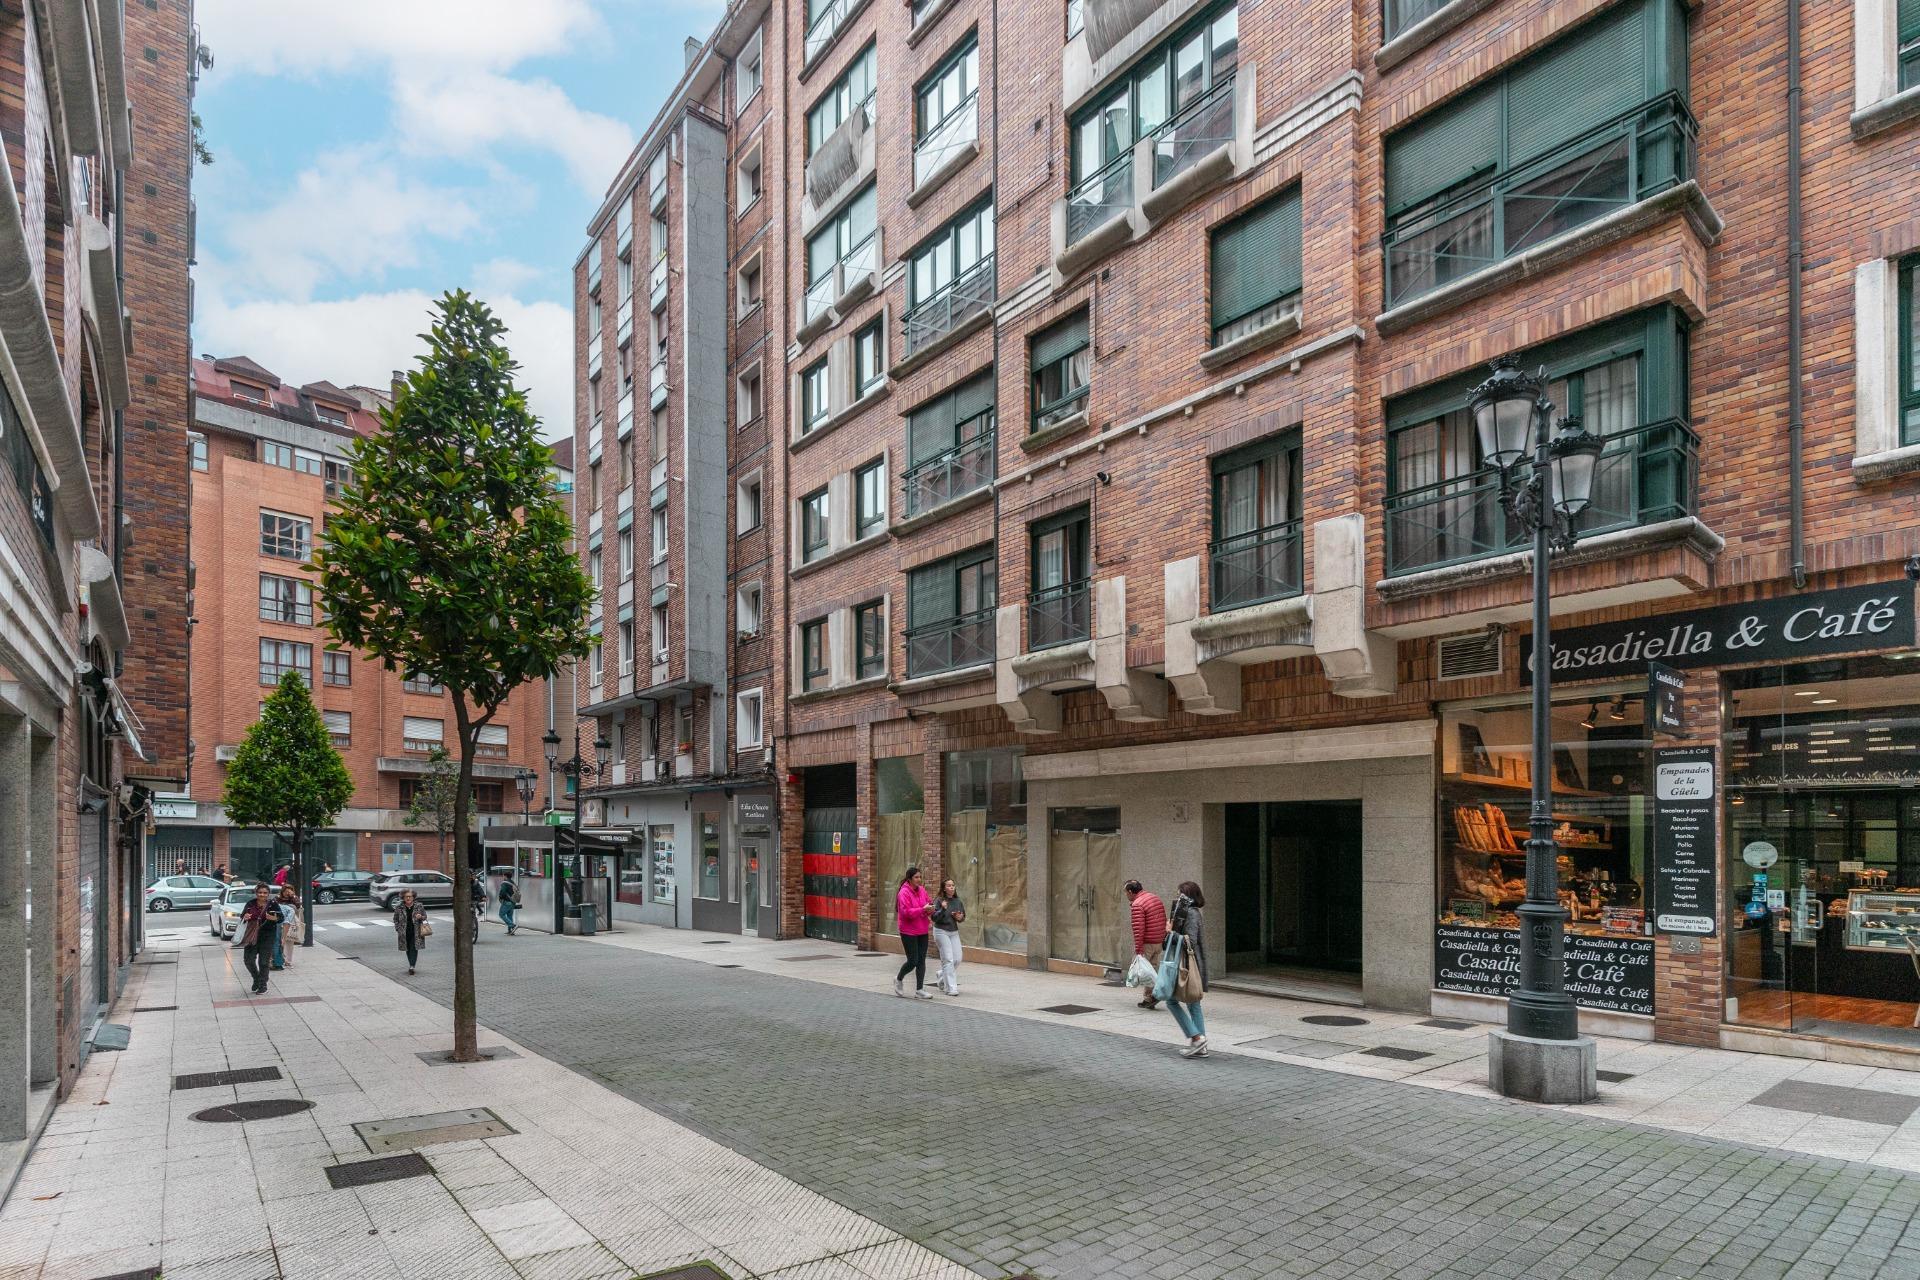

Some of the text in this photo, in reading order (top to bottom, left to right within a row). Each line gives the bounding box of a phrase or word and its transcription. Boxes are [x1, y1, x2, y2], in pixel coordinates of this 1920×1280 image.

[1725, 615, 1769, 651] &
[1783, 596, 1900, 643] Café
[1660, 766, 1710, 777] Empanadas
[1670, 787, 1700, 796] Güela
[1437, 928, 1472, 938] Casadiella
[1482, 932, 1499, 940] Café
[1575, 938, 1618, 949] Casadiella
[1619, 942, 1629, 950] &
[1630, 942, 1652, 951] Café
[1440, 939, 1649, 966] Casadiella & Ca adiella & Café
[1457, 952, 1521, 973] Casadie
[1577, 963, 1626, 983] Café
[1438, 981, 1473, 992] Casadiella
[1482, 987, 1500, 995] Café
[1576, 997, 1619, 1009] Casadiella
[1620, 1002, 1629, 1010] &
[1631, 1003, 1653, 1013] Café
[1440, 968, 1489, 982] Casadiella
[1491, 974, 1502, 983] &
[1504, 974, 1521, 986] Ca
[1563, 982, 1601, 994] adiella
[1604, 985, 1617, 996] &
[1619, 987, 1649, 999] Café
